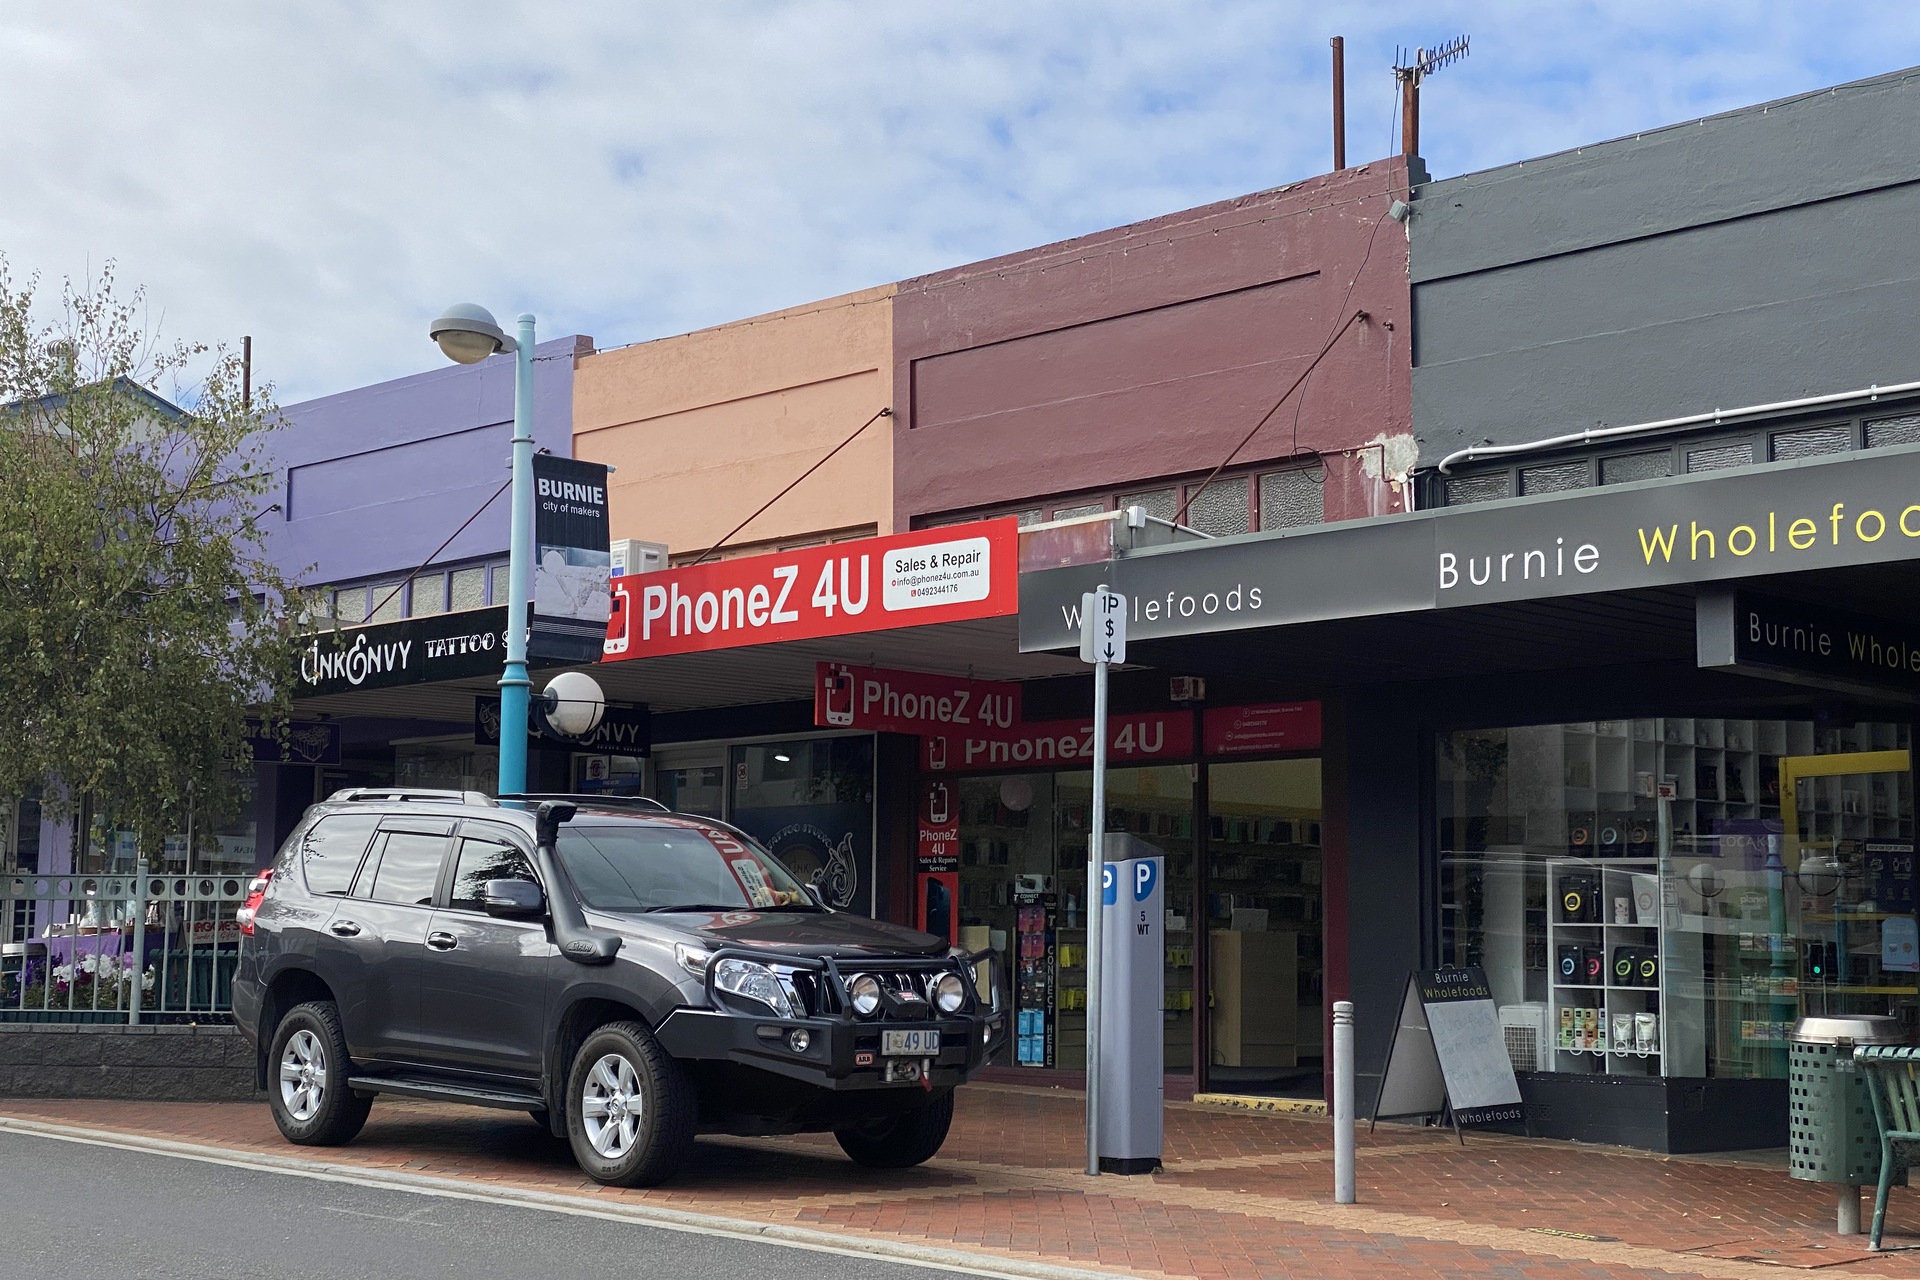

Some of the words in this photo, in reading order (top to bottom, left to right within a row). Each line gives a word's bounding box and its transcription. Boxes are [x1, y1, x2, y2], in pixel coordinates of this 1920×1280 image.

[537, 477, 604, 506] BURNIE
[542, 501, 558, 513] city
[560, 503, 569, 513] of
[570, 506, 601, 518] makers
[1438, 536, 1601, 590] Burnie
[1637, 502, 1920, 567] Wholefoo
[895, 558, 926, 574] Sales
[930, 554, 939, 569] &
[942, 549, 981, 569] Repair
[896, 569, 980, 587] info@phonez4u.com.au
[642, 564, 799, 641] PhoneZ
[811, 553, 870, 618] 4U
[917, 584, 958, 597] 0492344176
[1061, 583, 1262, 631] Wlefoods
[1101, 594, 1119, 614] 1P
[1104, 618, 1115, 639] $
[1749, 612, 1832, 656] Burnie
[424, 632, 496, 659] TATTOO
[862, 680, 971, 725] PhoneZ
[977, 694, 1014, 729] 4U
[1113, 721, 1165, 754] 4U
[919, 828, 957, 842] PhoneZ
[931, 842, 945, 855] 4U
[932, 856, 938, 864] &
[939, 856, 957, 865] Repairs
[1136, 863, 1151, 894] P
[1140, 910, 1146, 922] 5
[1137, 923, 1150, 935] WT
[1046, 945, 1054, 1015] CONNECT
[1434, 971, 1469, 984] Burnie
[1423, 985, 1488, 999] Wholefoods
[1458, 1108, 1521, 1125] Wholefoods
